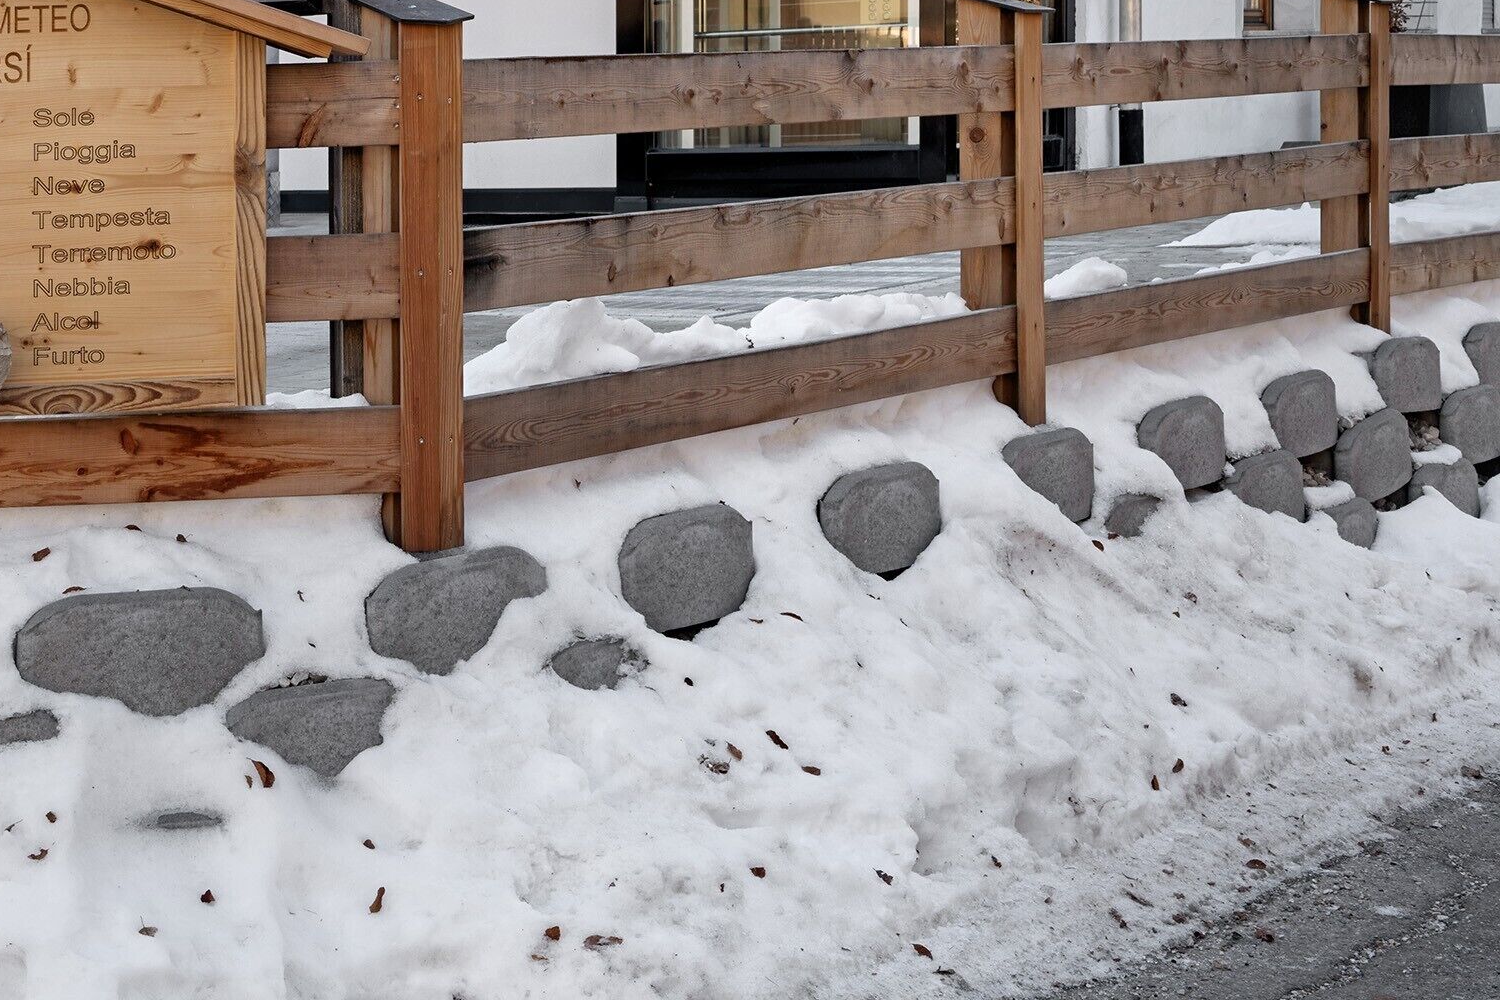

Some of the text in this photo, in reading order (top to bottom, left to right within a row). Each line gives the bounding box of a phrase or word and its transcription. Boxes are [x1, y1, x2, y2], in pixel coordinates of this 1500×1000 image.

[32, 108, 95, 127] Sole
[33, 140, 136, 164] Pioggia
[32, 176, 105, 195] Neve
[32, 207, 171, 232] Tempesta
[32, 242, 176, 264] Terremoto
[32, 277, 131, 298] Nebbia
[32, 311, 100, 332] Alcol
[33, 345, 105, 366] Furto
